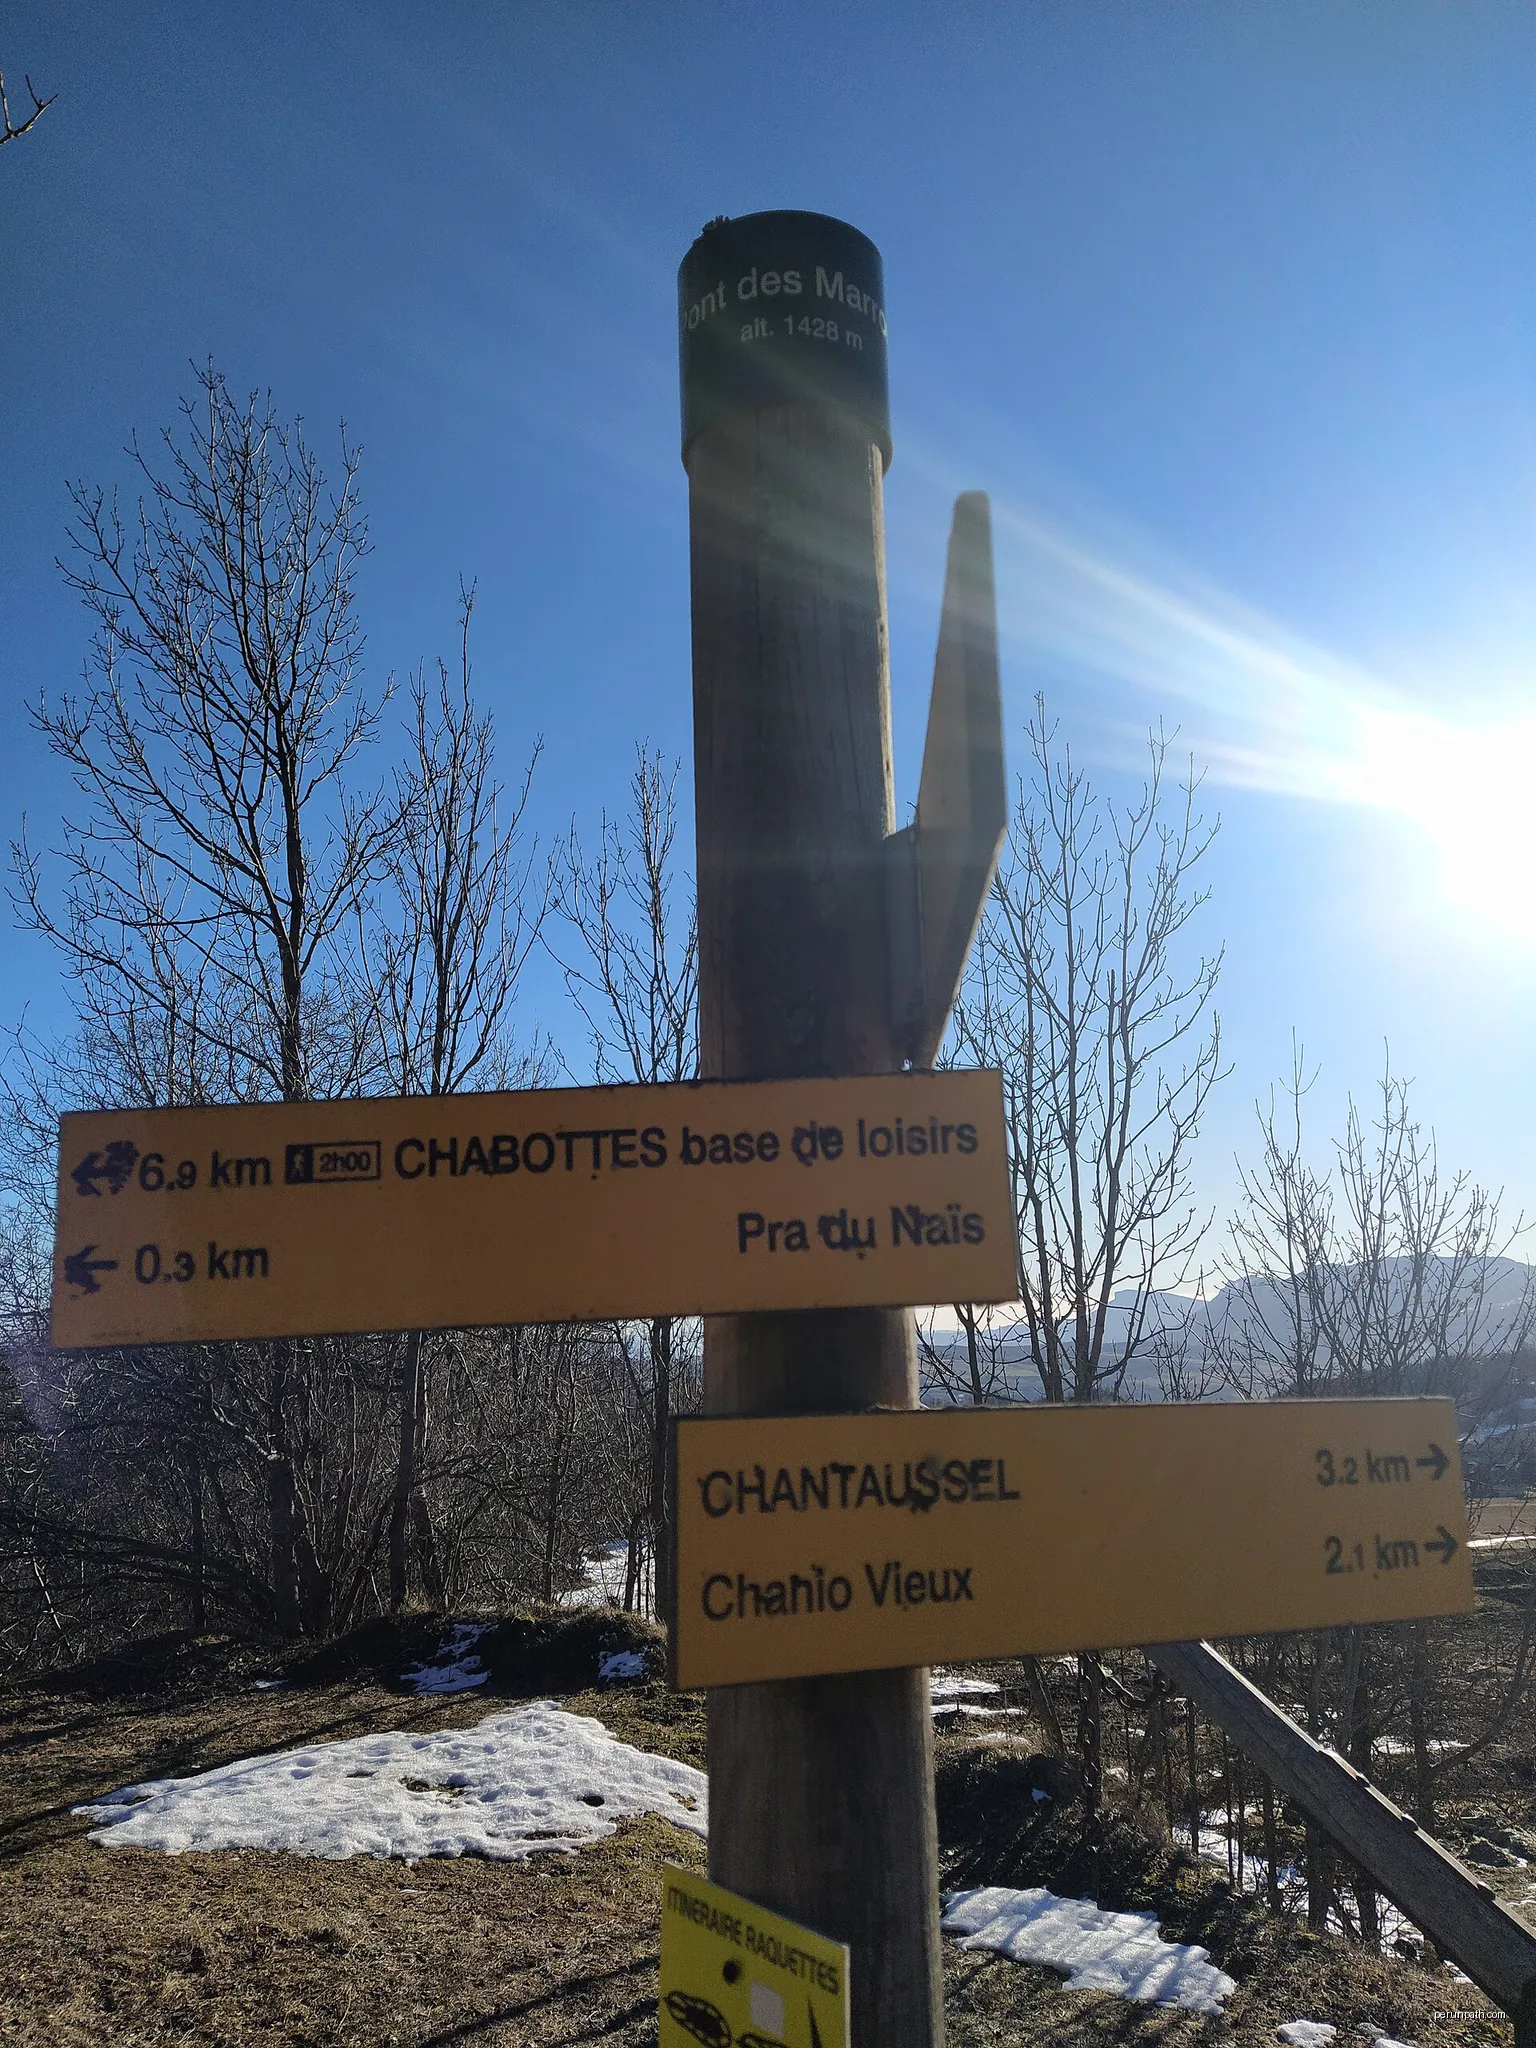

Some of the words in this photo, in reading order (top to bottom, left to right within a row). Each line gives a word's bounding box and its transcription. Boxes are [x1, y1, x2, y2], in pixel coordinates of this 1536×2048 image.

[683, 280, 727, 330] ont
[737, 266, 803, 300] des
[740, 317, 774, 342] alt.
[784, 314, 840, 342] 1428
[845, 328, 864, 351] m
[138, 1152, 197, 1192] 6.9
[210, 1150, 272, 1189] km
[318, 1151, 371, 1173] 2h00
[394, 1127, 668, 1180] CHABOTTES
[680, 1126, 780, 1165] base
[791, 1121, 844, 1165] de
[857, 1116, 979, 1158] loisirs
[134, 1244, 196, 1285] 0.3
[206, 1242, 270, 1280] km
[737, 1211, 810, 1253] Pra
[818, 1208, 877, 1251] du
[890, 1202, 986, 1248] Naïs
[701, 1458, 1021, 1519] CHANTAUSSEL
[1315, 1448, 1359, 1487] 3.2
[1365, 1447, 1411, 1484] km
[865, 1560, 974, 1608] Vieux
[1324, 1535, 1365, 1575] 2.1
[1374, 1533, 1420, 1571] km
